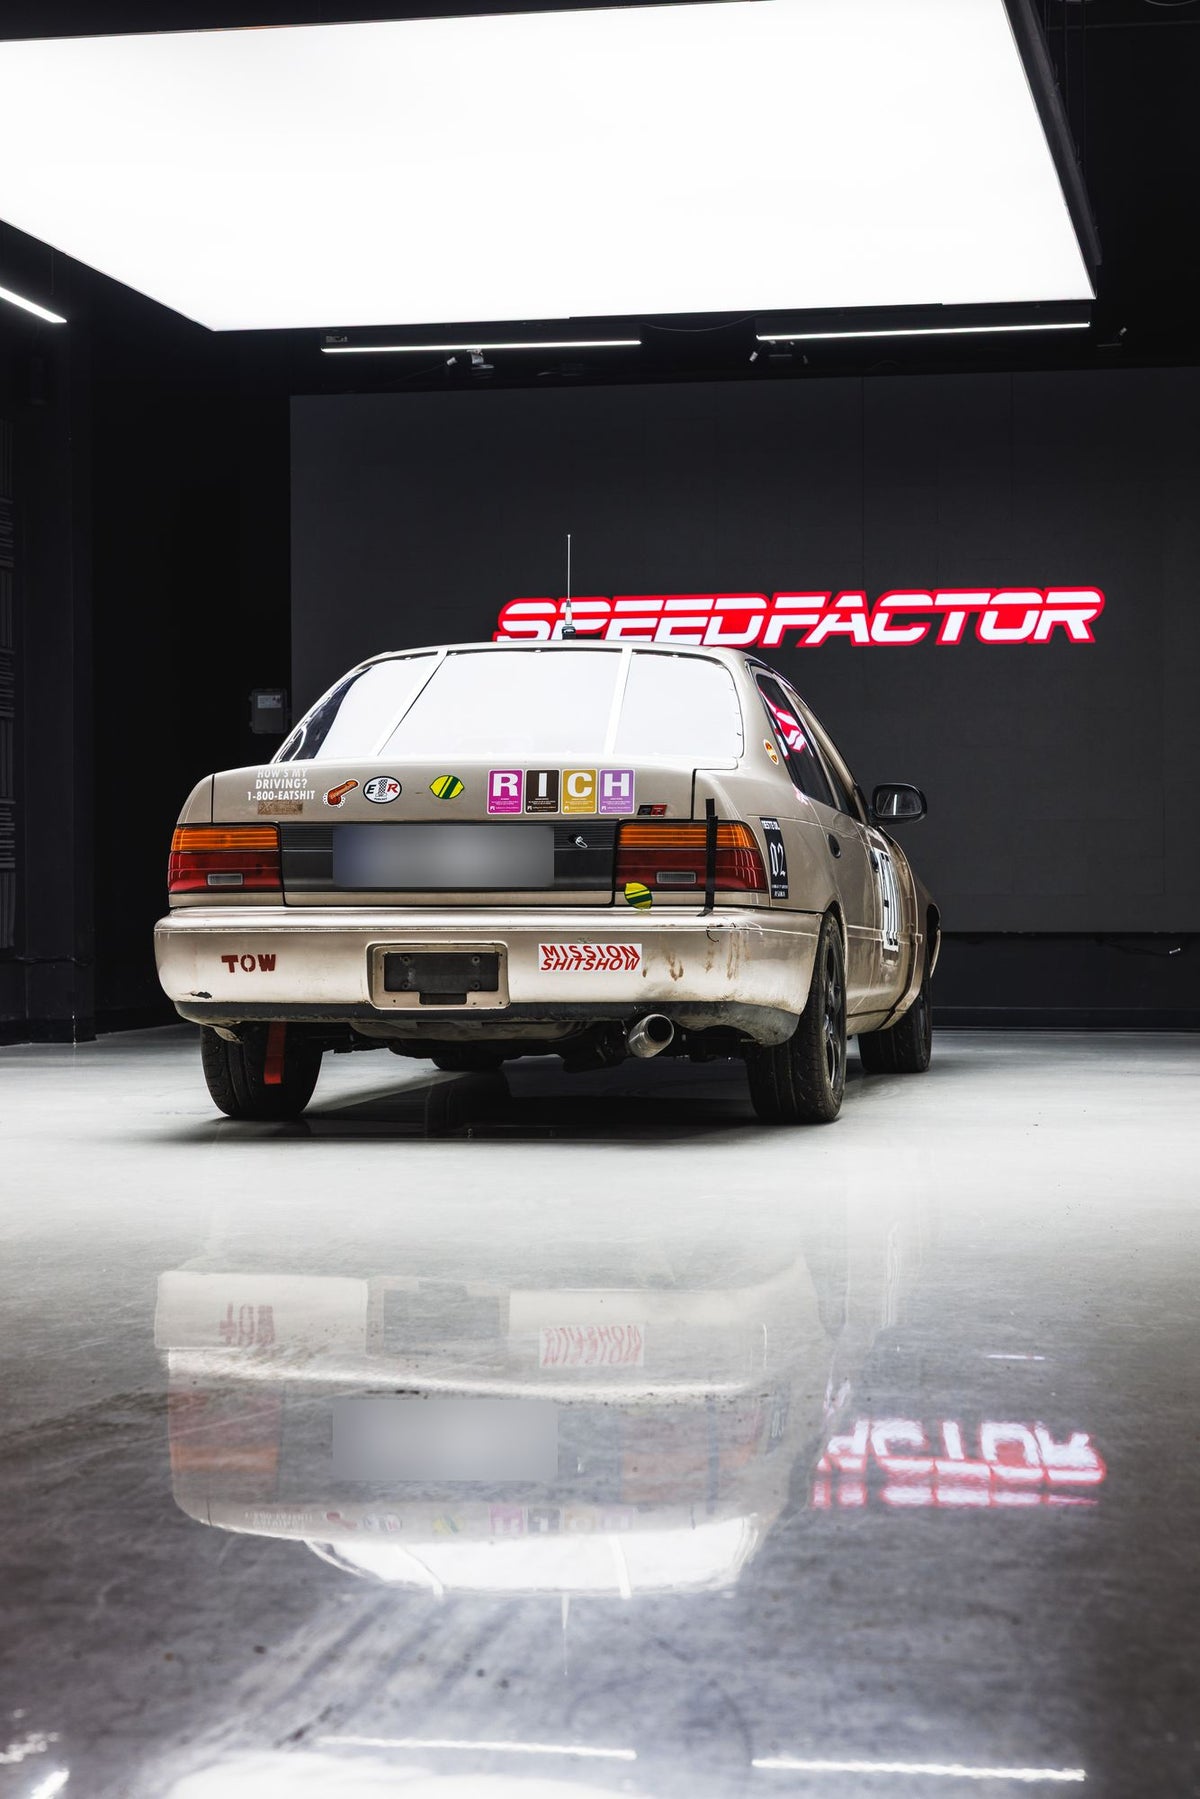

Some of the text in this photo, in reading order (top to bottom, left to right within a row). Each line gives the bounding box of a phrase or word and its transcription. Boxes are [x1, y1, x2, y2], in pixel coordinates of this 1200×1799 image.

[493, 586, 1106, 648] SPEEDFACTOR
[292, 768, 308, 778] MY
[255, 778, 308, 789] DRIVING?
[247, 790, 316, 801] 1-800-EATSHIT
[769, 842, 786, 877] 02
[540, 944, 640, 961] MISSION
[221, 954, 277, 973] TOW
[540, 957, 640, 971] SHITSHOW
